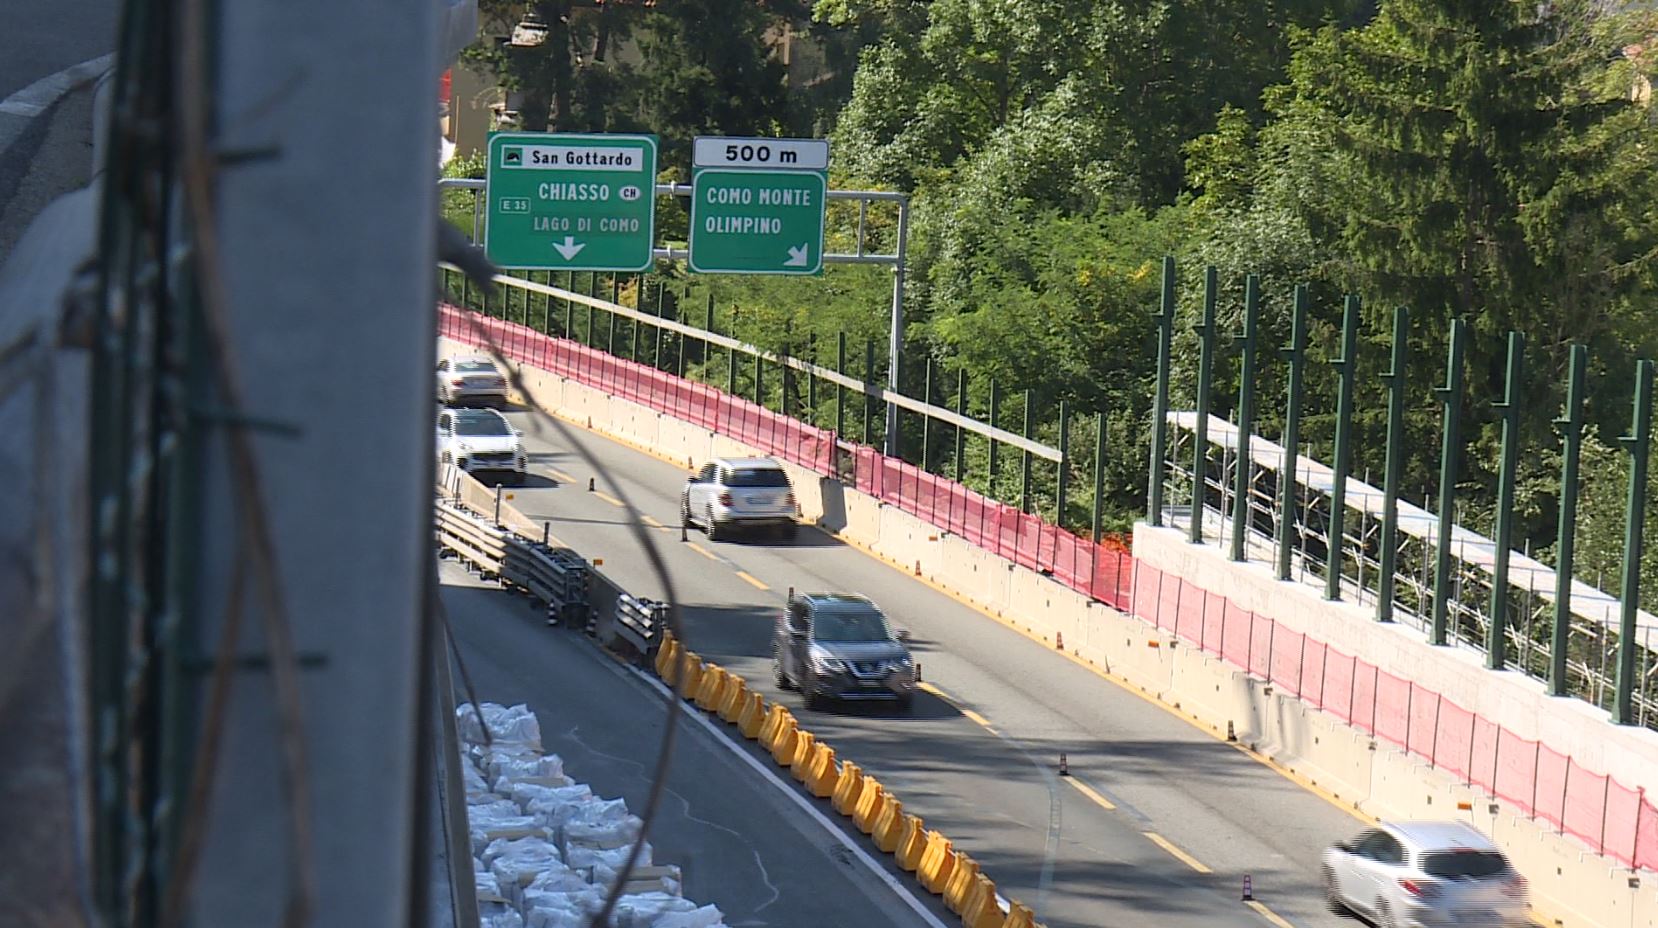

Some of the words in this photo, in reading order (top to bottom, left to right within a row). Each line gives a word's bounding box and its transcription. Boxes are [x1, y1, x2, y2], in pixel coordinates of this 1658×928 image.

[533, 150, 558, 165] San
[566, 150, 632, 166] Gottardo
[726, 145, 770, 161] 500
[780, 150, 797, 163] m
[539, 183, 609, 201] CHIASSO
[623, 188, 636, 198] CH
[707, 188, 751, 205] COMO
[759, 189, 810, 206] MONTE
[503, 201, 510, 210] E
[514, 201, 527, 210] 35
[534, 217, 572, 232] LAGO
[578, 217, 591, 232] DI
[600, 218, 639, 232] COMO
[706, 217, 781, 234] OLIMPINO
